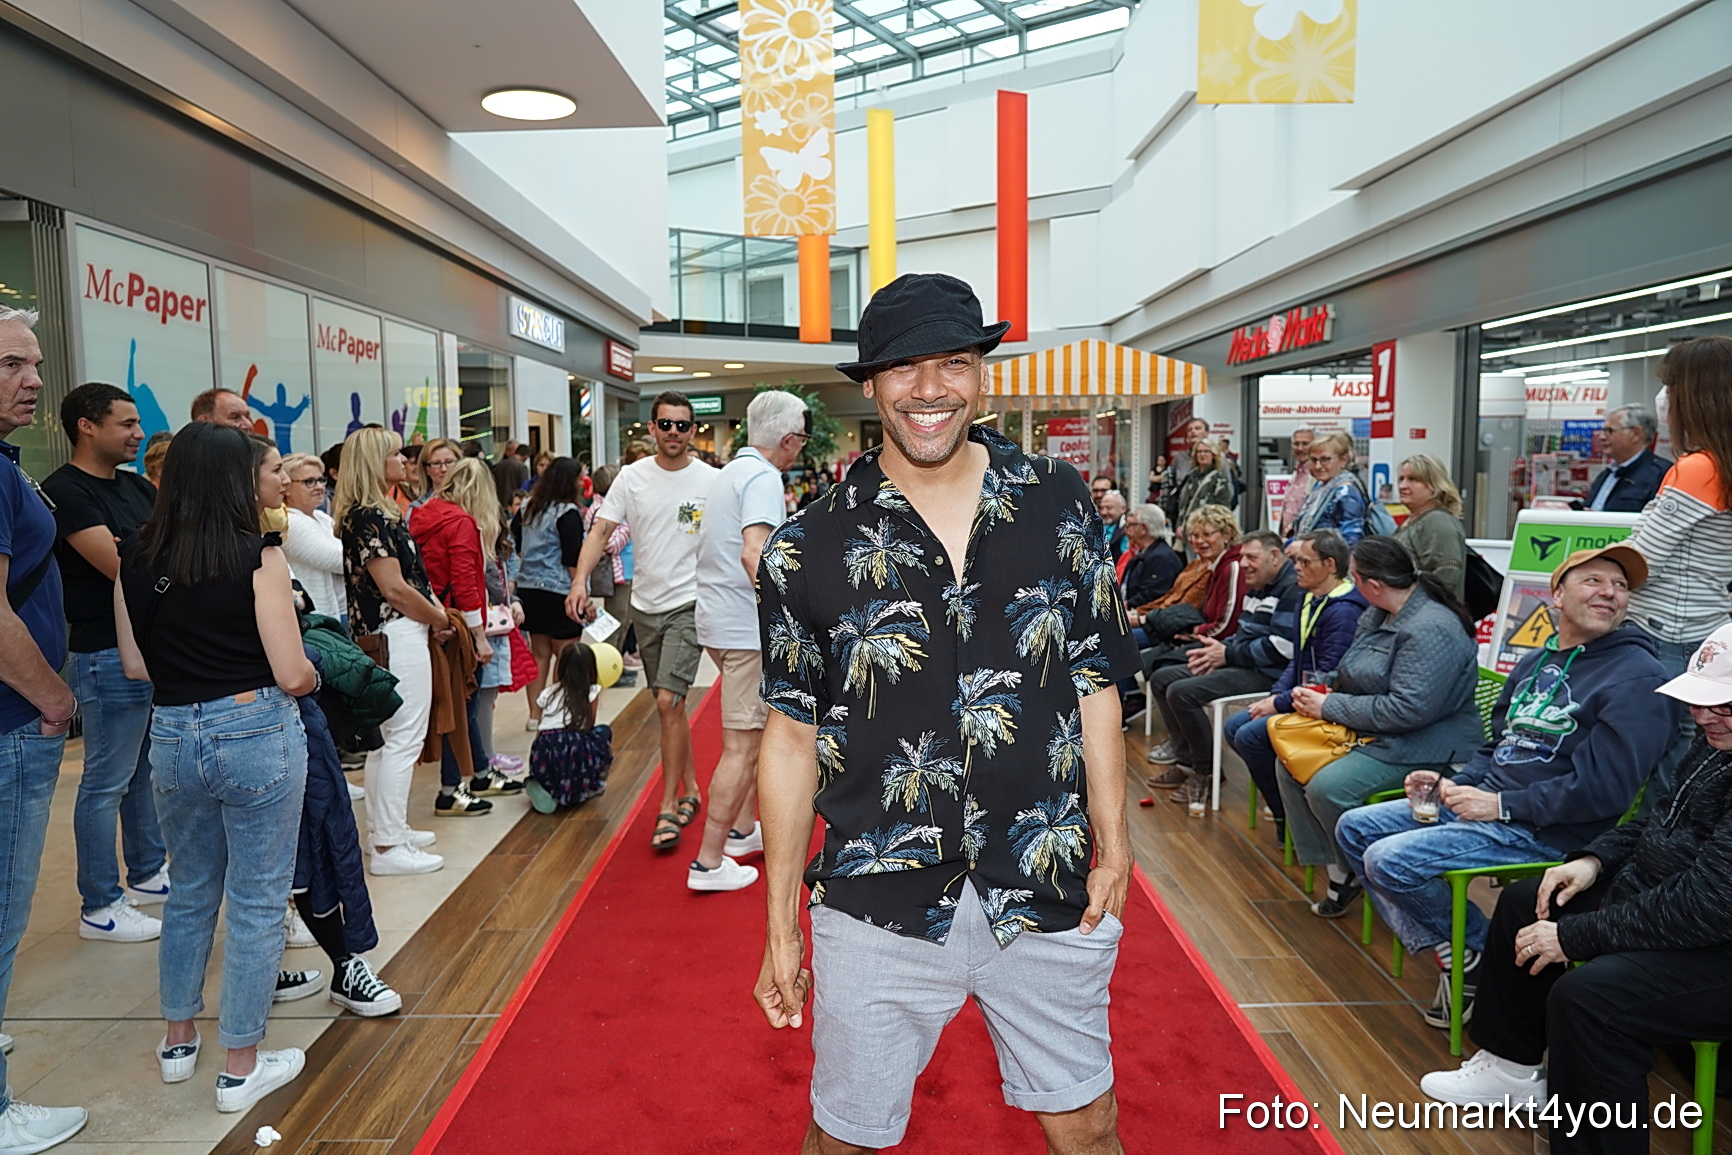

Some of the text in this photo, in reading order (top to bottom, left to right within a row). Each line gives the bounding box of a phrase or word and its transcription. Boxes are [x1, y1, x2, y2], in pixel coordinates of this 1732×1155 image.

[84, 263, 207, 325] McPaper
[316, 323, 380, 364] McPaper
[1377, 347, 1392, 398] 1
